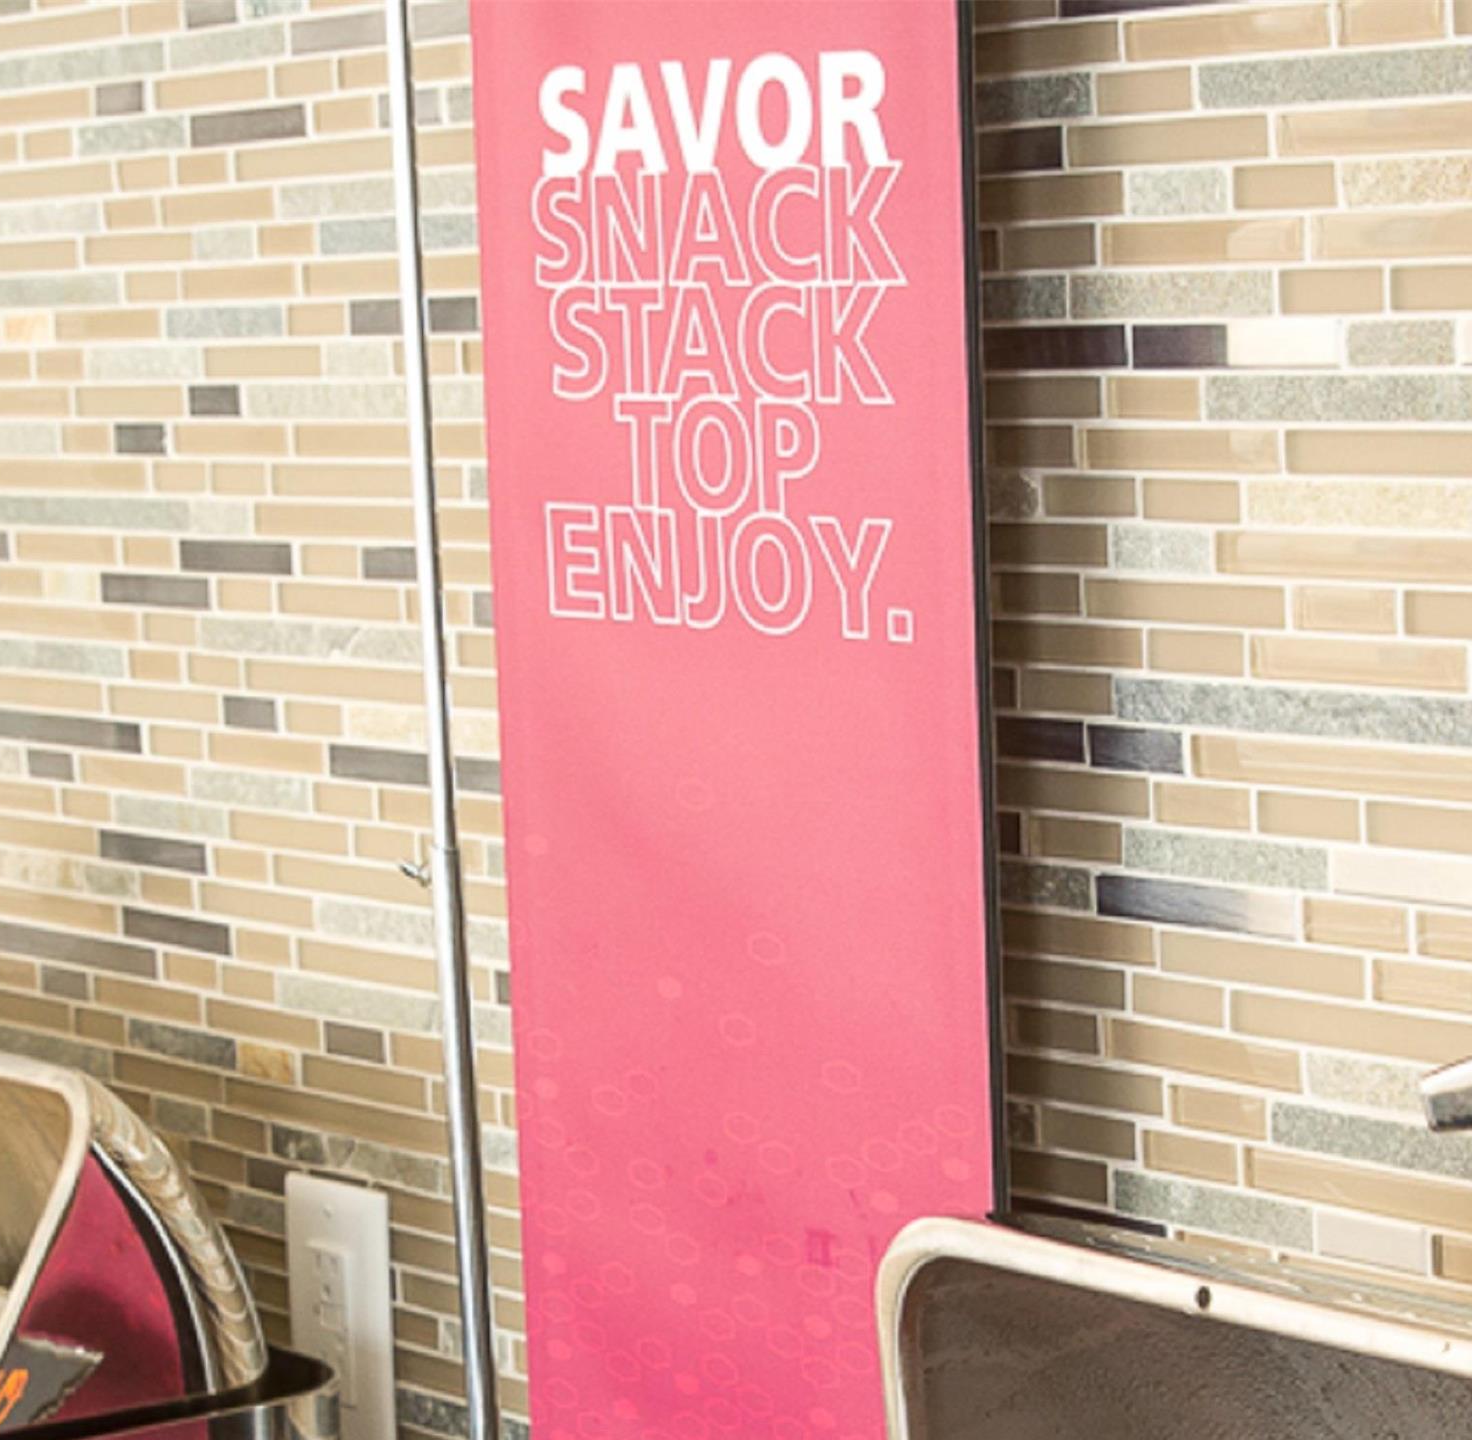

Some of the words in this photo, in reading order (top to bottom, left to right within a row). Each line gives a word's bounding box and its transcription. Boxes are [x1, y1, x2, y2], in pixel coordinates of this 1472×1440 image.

[539, 50, 890, 177] SAVOR
[533, 162, 905, 287] SNACK
[548, 279, 895, 406] STACK
[613, 394, 820, 518] TOP
[545, 503, 913, 642] ENJOY.
